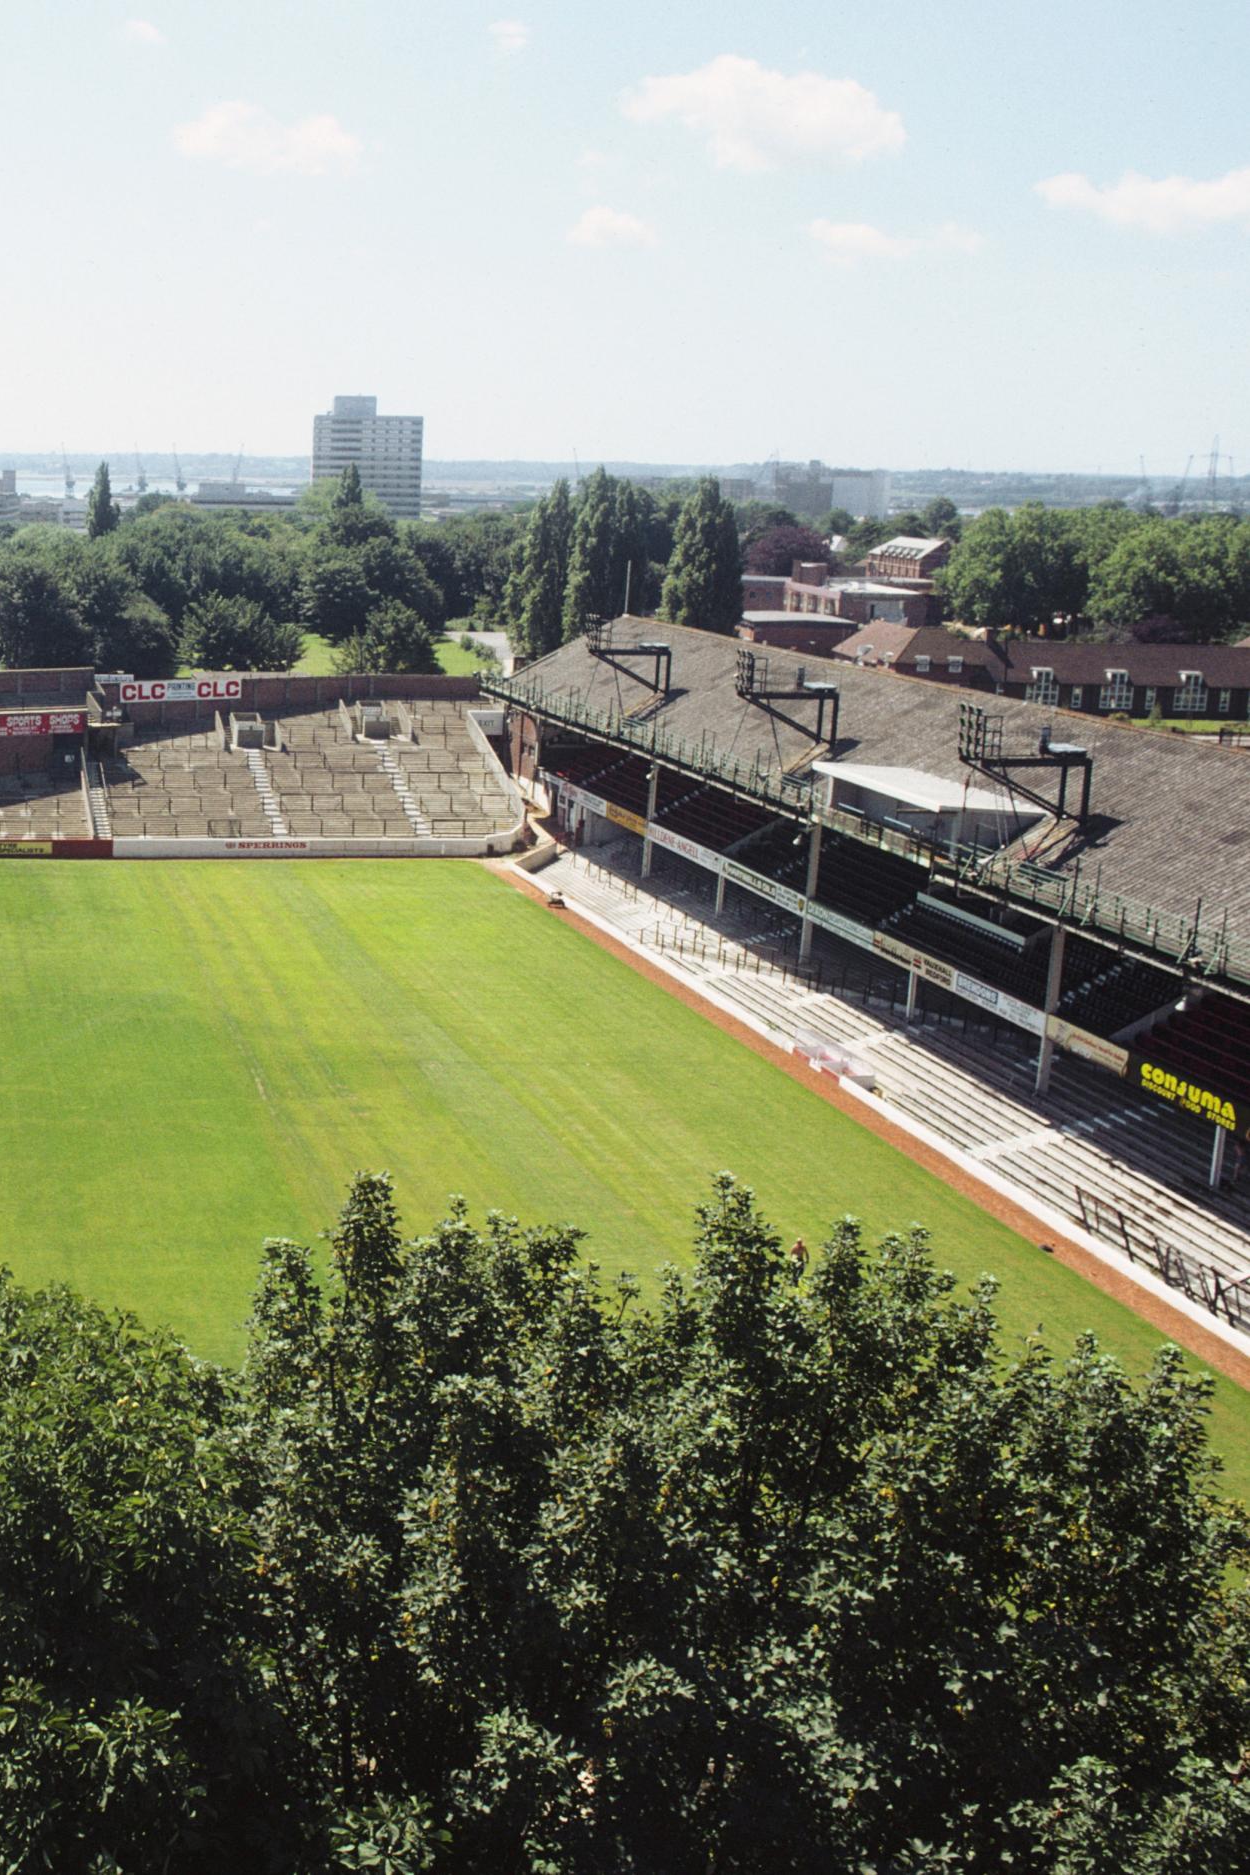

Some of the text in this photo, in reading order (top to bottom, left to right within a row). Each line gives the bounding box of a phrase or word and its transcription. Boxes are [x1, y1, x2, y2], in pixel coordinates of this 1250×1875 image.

[121, 682, 166, 701] CLC
[166, 682, 195, 691] PRINTING
[196, 680, 240, 698] CLC
[6, 715, 42, 727] SPORTS
[49, 714, 80, 725] SHOPS
[237, 841, 307, 849] SPERRINGS
[923, 956, 952, 977] VAUXHALL
[925, 967, 952, 986] BEDFORD
[1140, 1063, 1236, 1122] CONSUMA
[1141, 1078, 1236, 1131] DISCOUNT FOOD STORES
